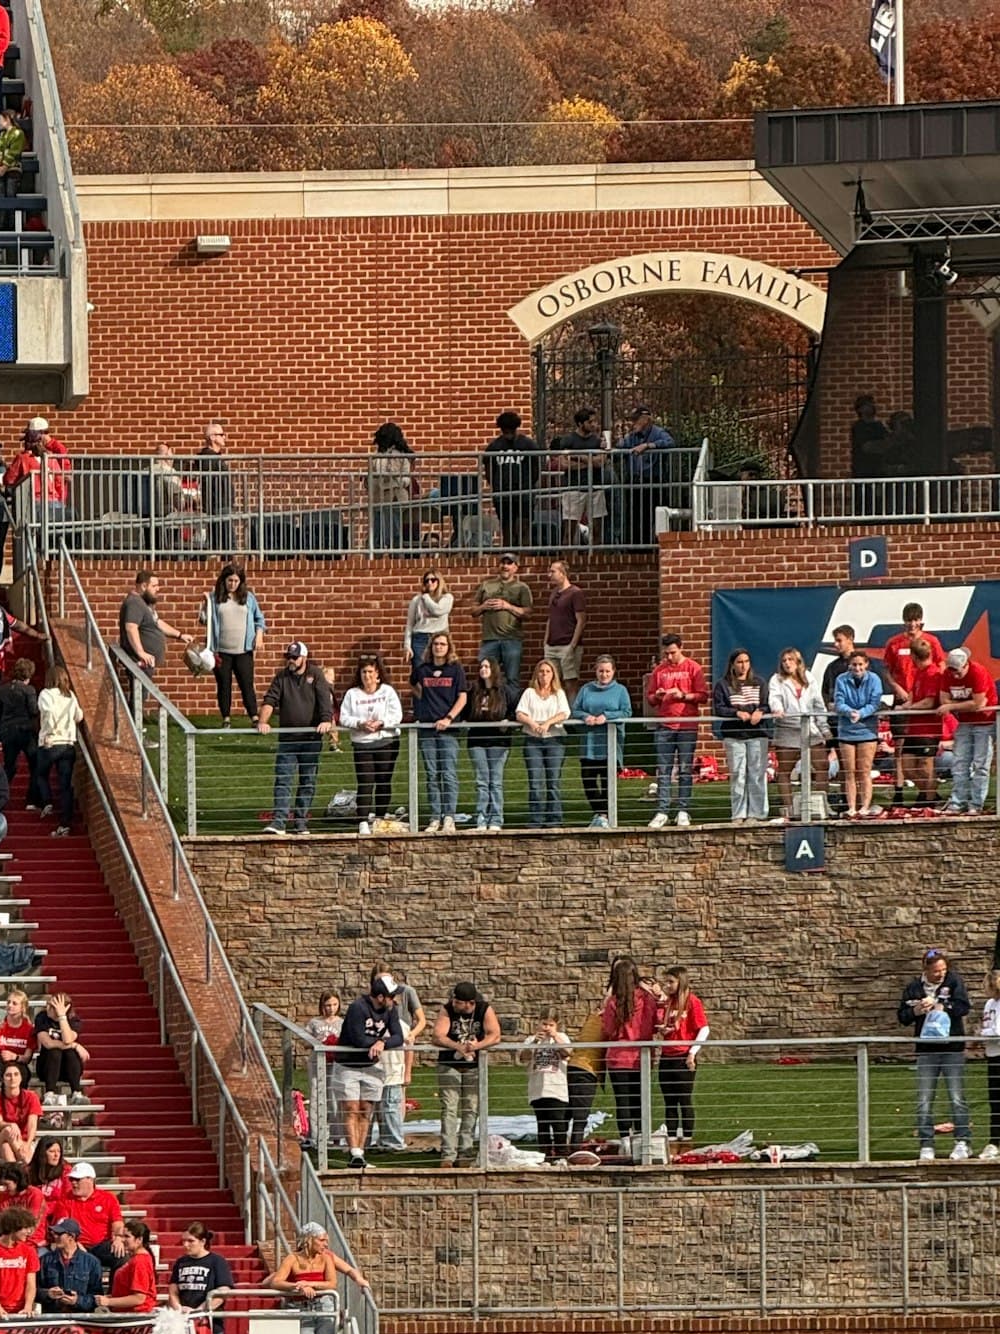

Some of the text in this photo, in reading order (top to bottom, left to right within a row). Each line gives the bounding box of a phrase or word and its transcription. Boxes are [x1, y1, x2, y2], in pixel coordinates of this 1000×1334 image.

[537, 259, 813, 318] OSBORNE FAMILY
[860, 550, 878, 568] D
[795, 839, 814, 858] A
